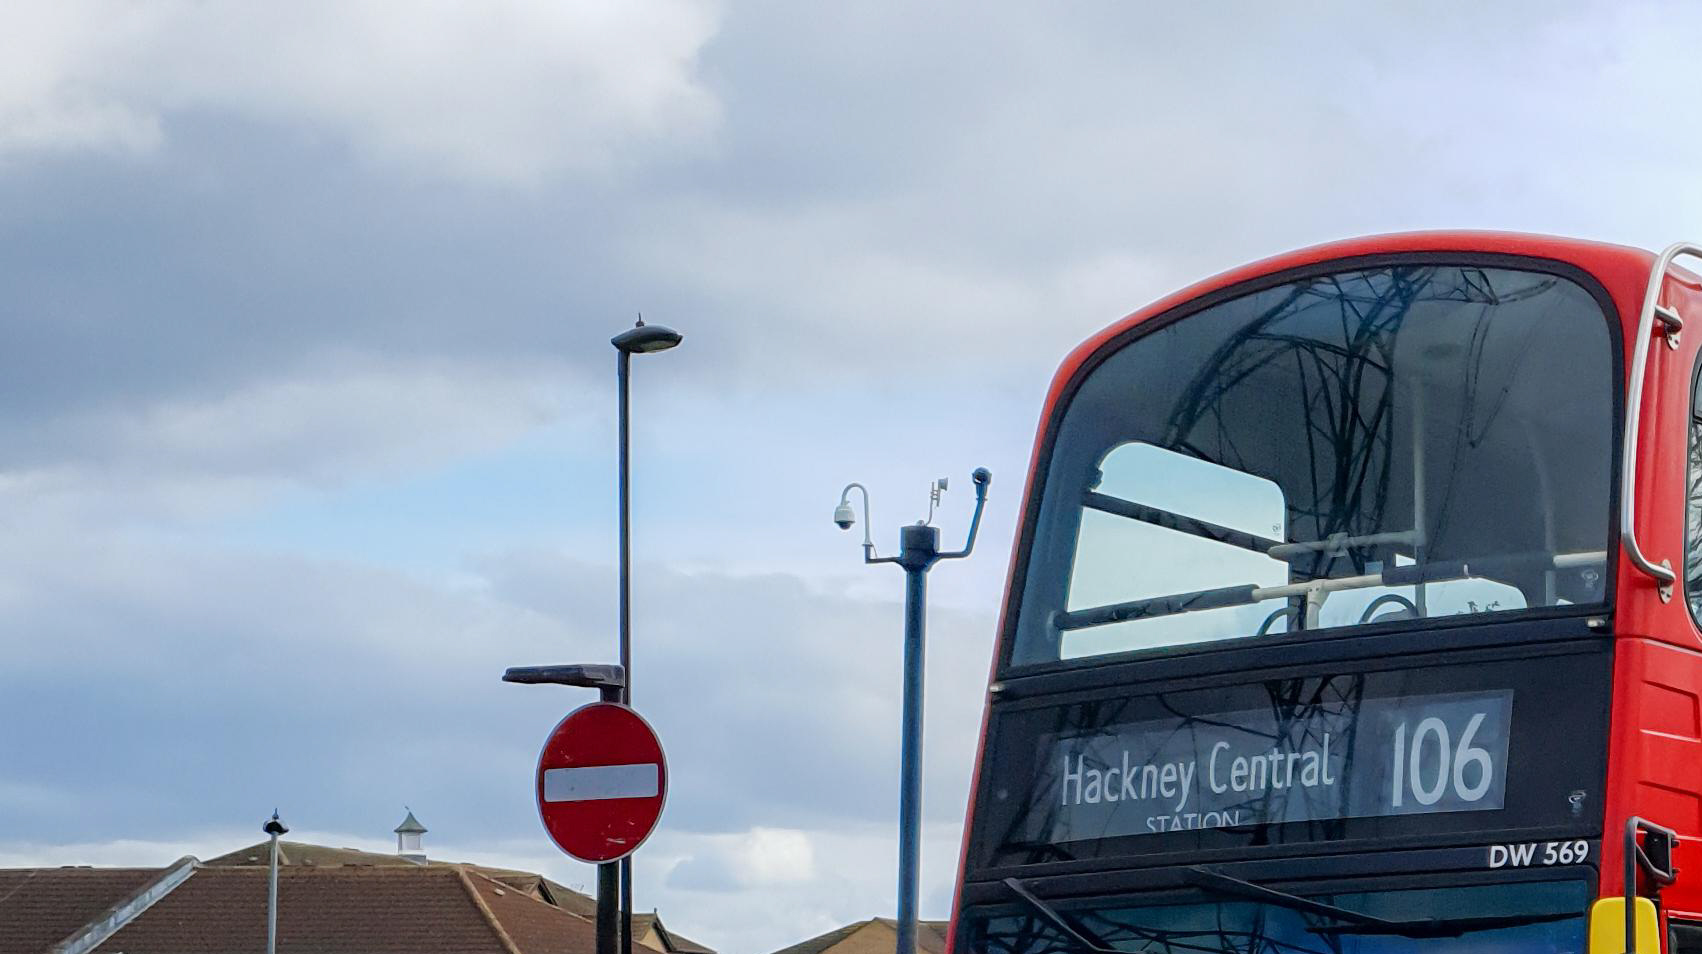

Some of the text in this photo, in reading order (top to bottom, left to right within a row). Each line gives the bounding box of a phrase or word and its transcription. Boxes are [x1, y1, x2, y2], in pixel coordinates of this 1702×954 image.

[1062, 733, 1335, 812] Hackney Central
[1393, 713, 1492, 807] 106
[1146, 811, 1240, 832] STATION
[1489, 840, 1589, 868] DW 569
